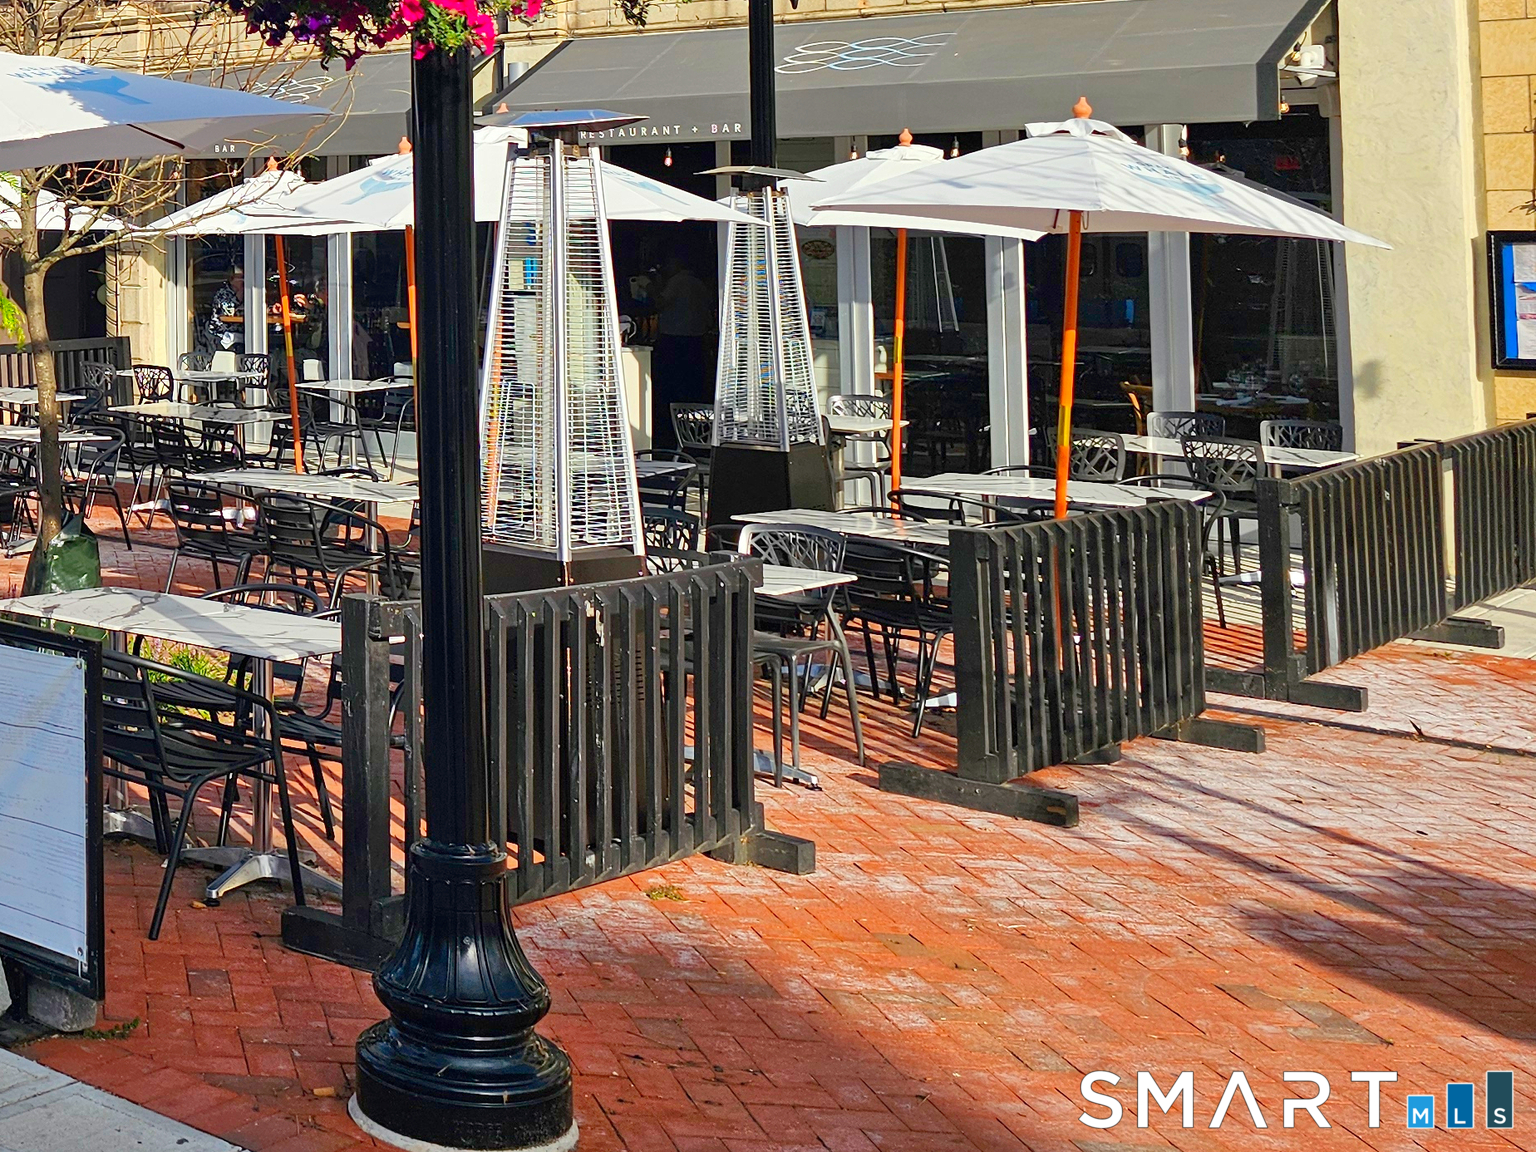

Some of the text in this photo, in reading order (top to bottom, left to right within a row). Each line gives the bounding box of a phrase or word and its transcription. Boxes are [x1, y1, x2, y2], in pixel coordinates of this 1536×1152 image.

[580, 125, 681, 140] RESTAURANT
[711, 123, 742, 134] BAR
[214, 144, 236, 153] BAR
